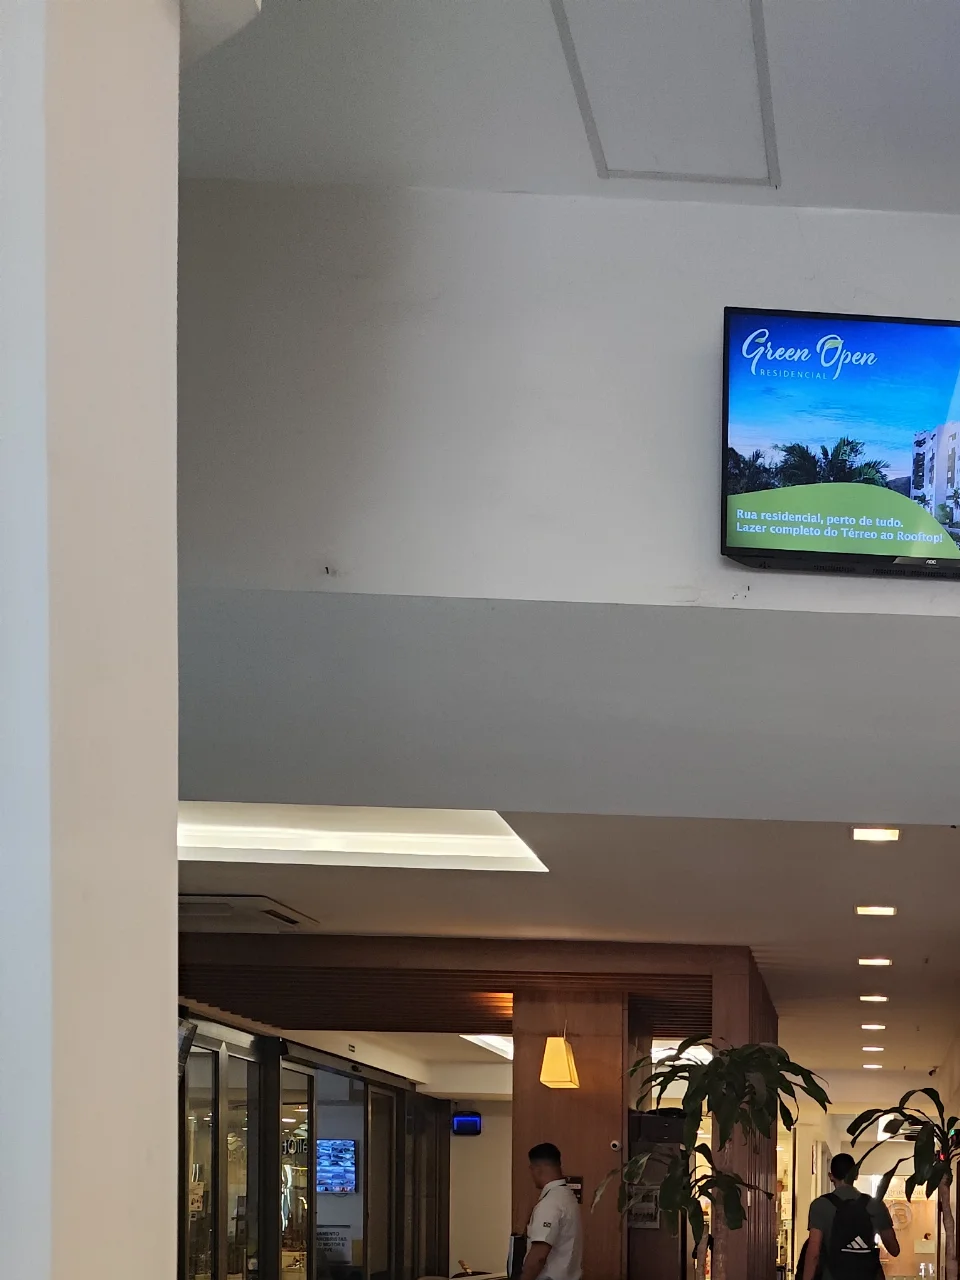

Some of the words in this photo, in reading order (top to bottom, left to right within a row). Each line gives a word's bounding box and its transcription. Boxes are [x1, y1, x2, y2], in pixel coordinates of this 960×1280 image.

[742, 328, 811, 376] Green
[816, 334, 878, 380] Open
[760, 368, 828, 380] RESIDENCIAL
[736, 509, 758, 520] Rua
[760, 511, 824, 525] residencial,
[826, 514, 856, 528] perto
[858, 515, 873, 526] de
[875, 517, 904, 528] tudo.
[736, 522, 767, 533] Lazer
[769, 524, 821, 536] completo
[823, 527, 838, 537] do
[840, 527, 878, 540] Térreo
[880, 531, 894, 540] ao
[897, 531, 943, 544] Rooftop!
